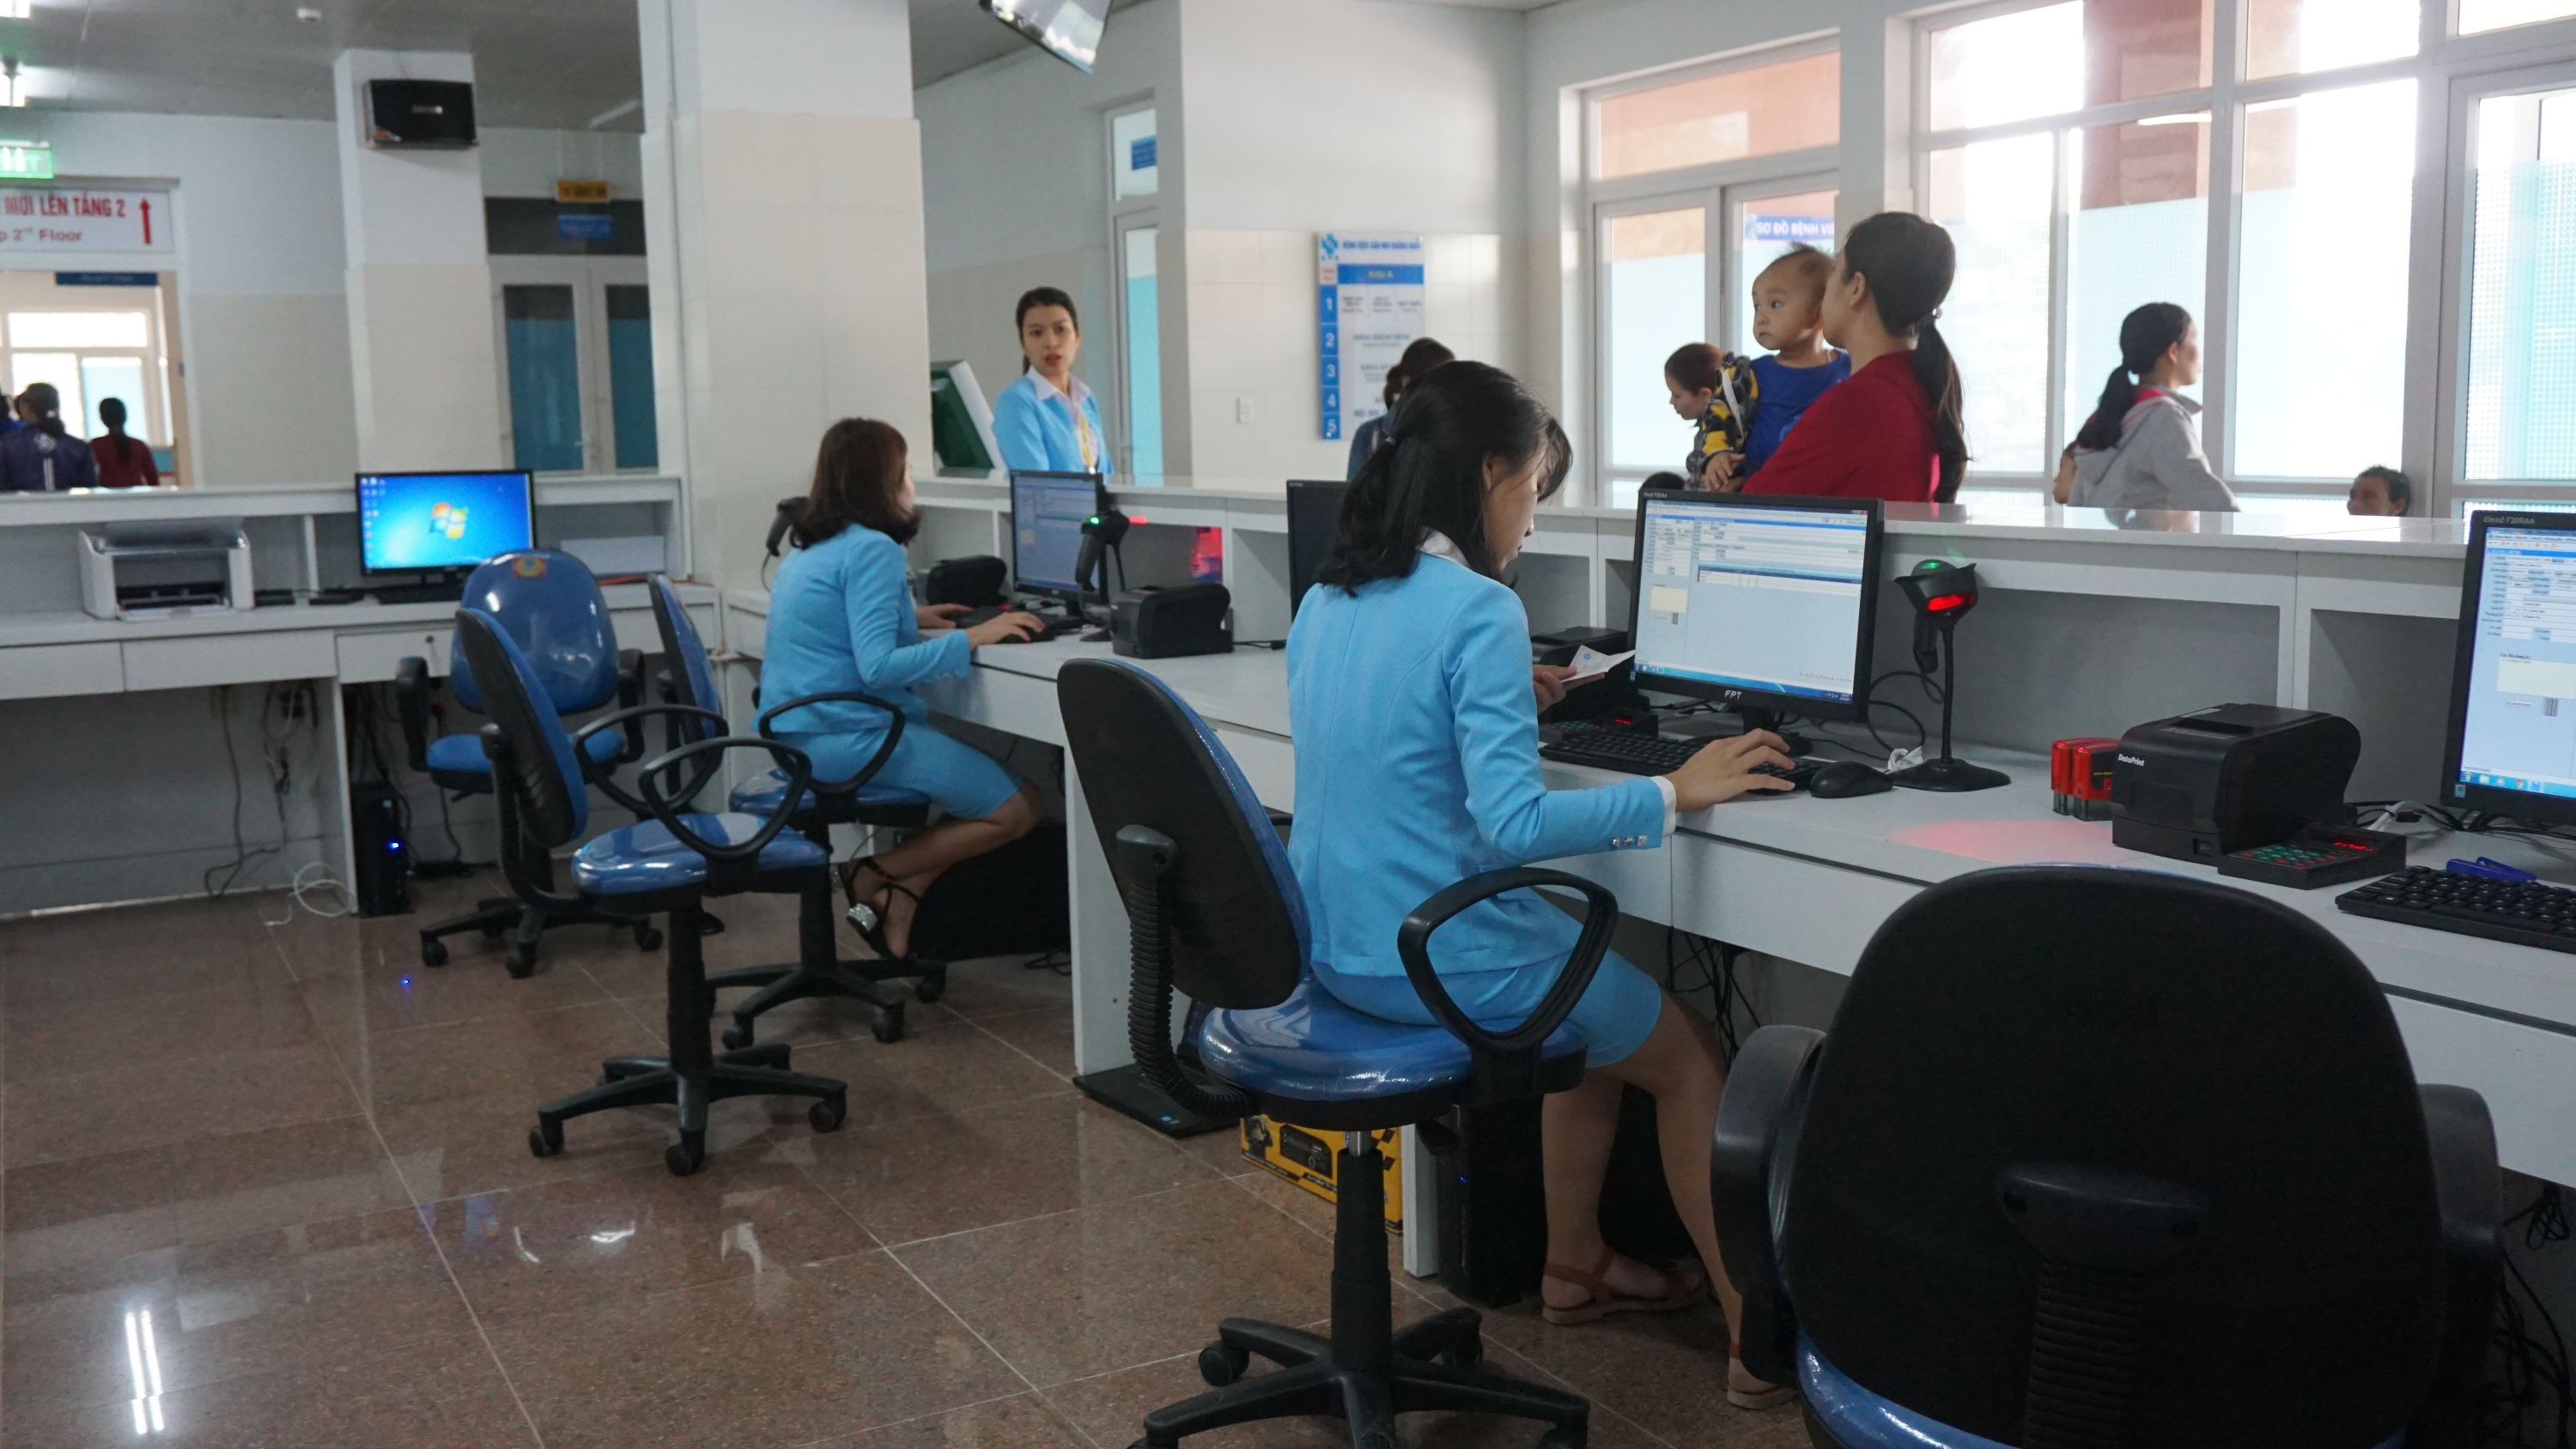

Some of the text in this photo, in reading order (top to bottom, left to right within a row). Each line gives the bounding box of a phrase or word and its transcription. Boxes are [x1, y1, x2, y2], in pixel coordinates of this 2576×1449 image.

[116, 197, 126, 218] 2
[39, 227, 82, 241] Floor
[1326, 296, 1333, 311] 1
[1326, 332, 1335, 347] 2
[1327, 363, 1336, 378] 3
[1327, 393, 1336, 408] 4
[1327, 418, 1337, 433] 5
[1724, 689, 1742, 700] FPT
[2117, 753, 2145, 767] DataPrint
